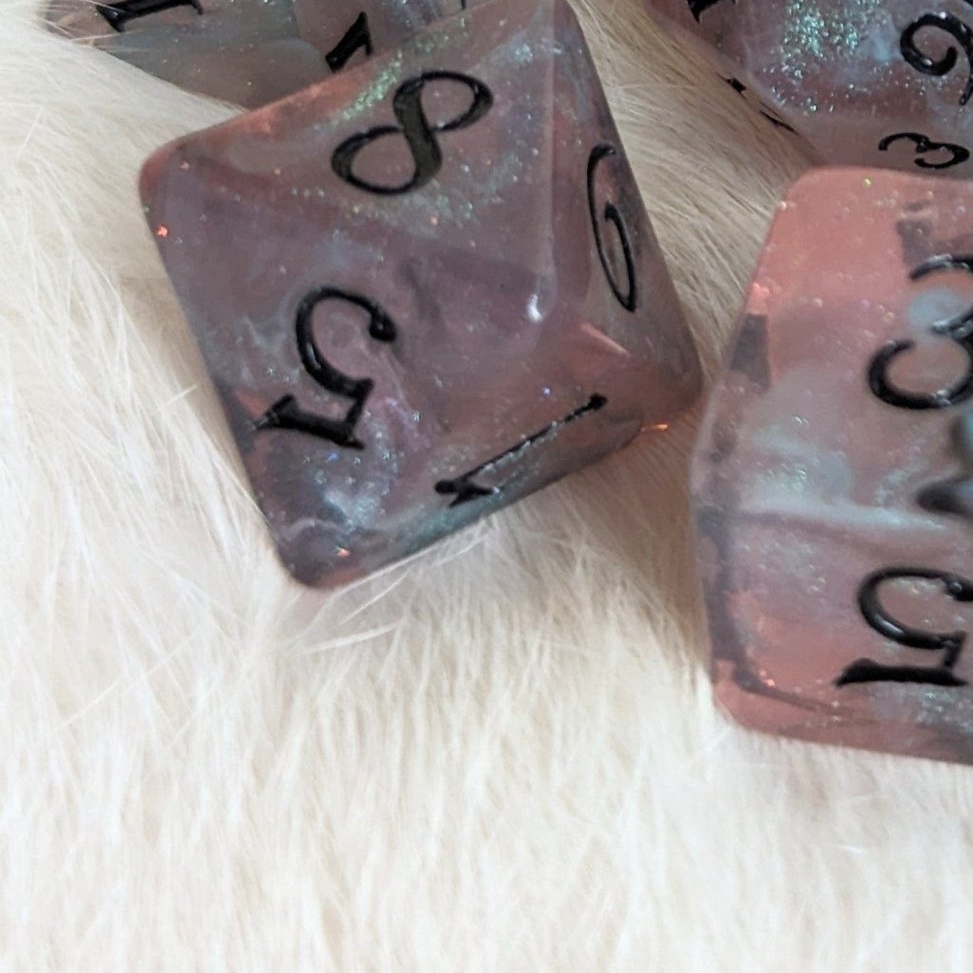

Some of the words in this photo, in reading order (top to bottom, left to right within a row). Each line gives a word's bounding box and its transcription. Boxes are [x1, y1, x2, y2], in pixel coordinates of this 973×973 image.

[331, 70, 493, 195] 8
[878, 132, 970, 169] 3
[254, 287, 396, 449] 5
